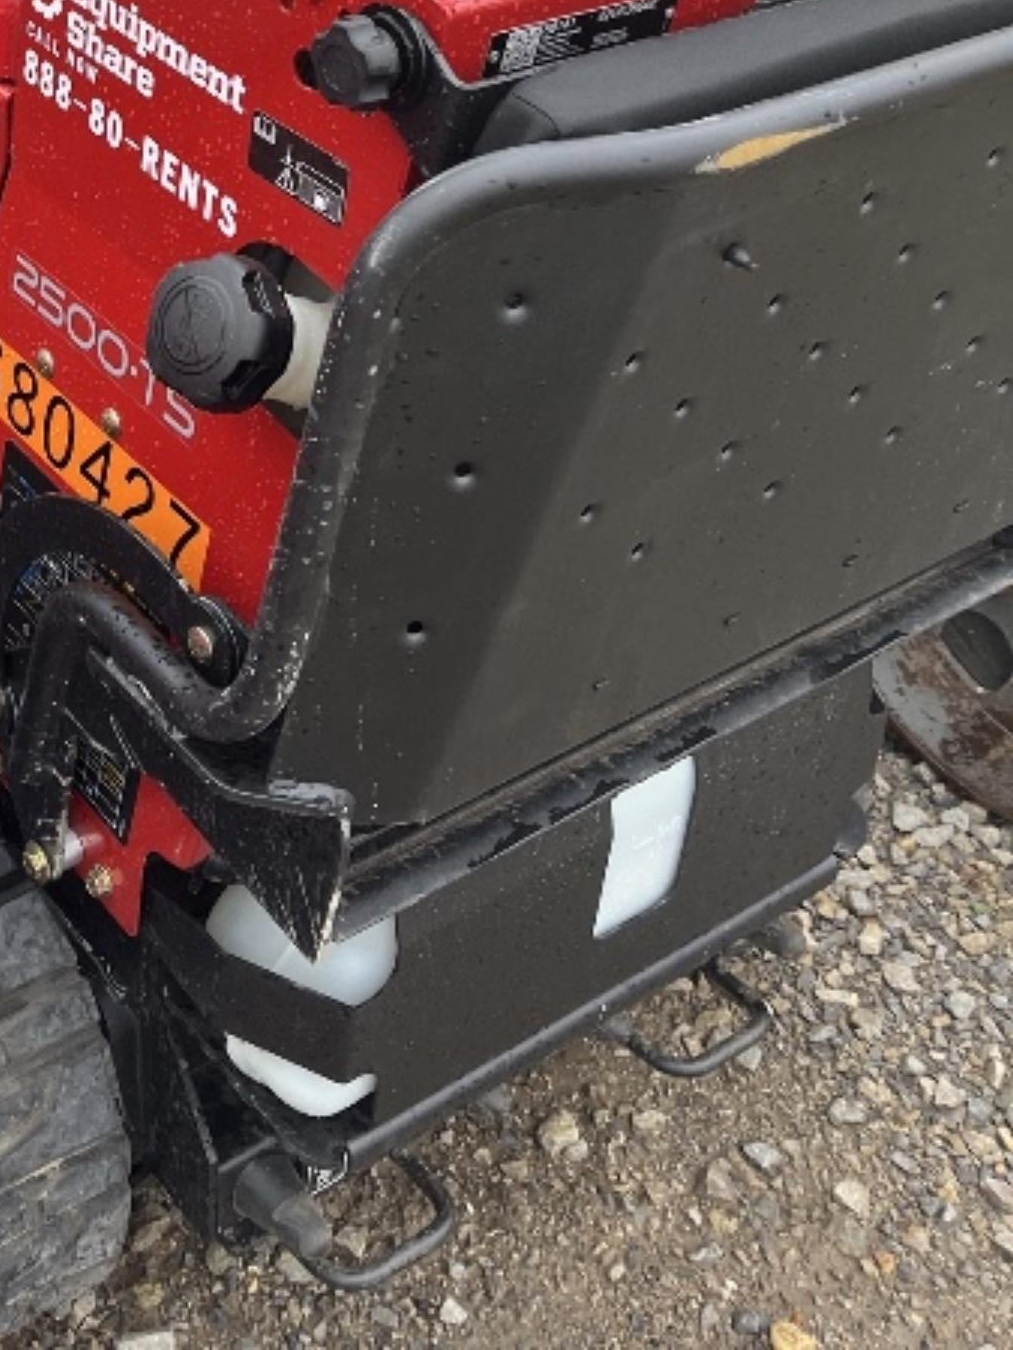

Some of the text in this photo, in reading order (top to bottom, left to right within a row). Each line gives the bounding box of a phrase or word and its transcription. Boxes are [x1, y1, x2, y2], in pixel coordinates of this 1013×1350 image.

[25, 19, 100, 85] CALL NOW
[65, 11, 157, 98] Share
[22, 50, 238, 238] 888-80-RENTS
